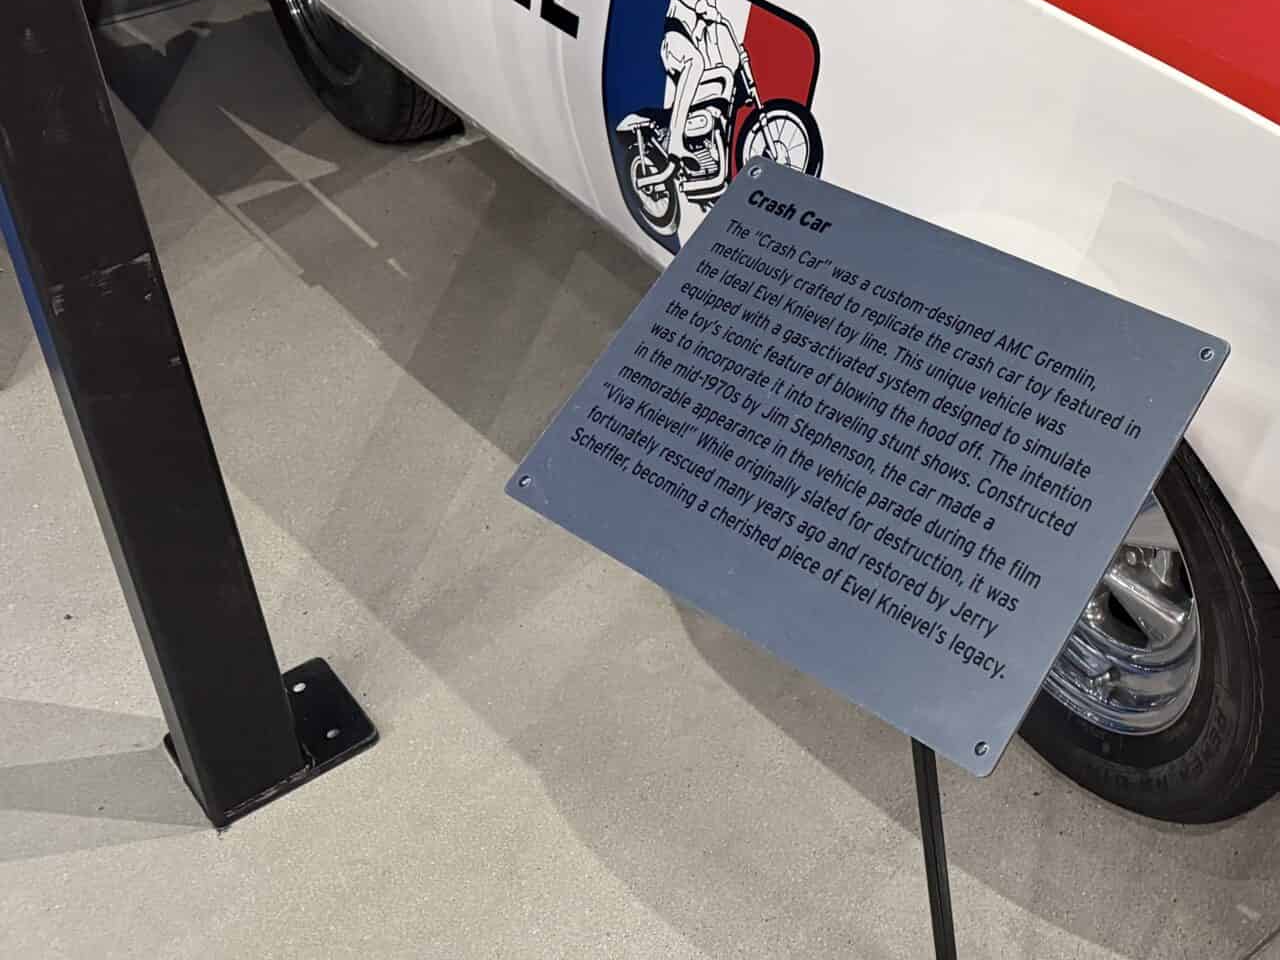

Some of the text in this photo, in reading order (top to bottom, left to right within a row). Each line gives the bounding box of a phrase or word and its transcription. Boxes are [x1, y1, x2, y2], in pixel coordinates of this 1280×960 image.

[725, 218, 750, 239] The
[831, 266, 859, 285] was
[859, 279, 870, 291] a
[872, 284, 995, 343] custom-designed
[993, 334, 1033, 359] AMC
[1034, 351, 1095, 392] Gremlin,
[747, 189, 832, 233] Crash Car
[633, 340, 995, 531] in the mid-1970s by Jim Stephenson, the car made a
[650, 322, 1078, 536] was to incorporate it into traveling stunt shows. Constructed
[665, 299, 688, 320] the
[721, 325, 763, 355] iconic
[762, 345, 814, 379] feature
[815, 372, 835, 386] of
[831, 377, 888, 417] blowing
[889, 404, 915, 427] the
[916, 417, 959, 446] hood
[957, 440, 984, 461] off.
[988, 449, 1017, 476] The
[1018, 464, 1092, 512] intention
[680, 282, 1091, 479] equipped with a gas-activated system designed to simulate
[695, 259, 1066, 435] the Ideal Evel Knievel toy line. This unique vehicle was
[710, 242, 1141, 439] meticulously crafted to replicate the crash car toy featured in
[570, 427, 630, 472] Scheffler,
[631, 459, 697, 509] becoming
[696, 499, 709, 512] a
[709, 506, 782, 551] cherished
[776, 544, 820, 574] piece
[821, 568, 843, 584] of
[840, 574, 877, 604] Evel
[947, 633, 1005, 679] legacy.
[586, 405, 999, 639] fortunately rescued many years ago and restored by Jerry
[617, 365, 1041, 589] memorable appearance in the vehicle parade during the film
[695, 431, 734, 461] While
[734, 455, 801, 499] originally
[800, 489, 850, 520] slated
[847, 510, 873, 533] for
[873, 526, 963, 587] destruction,
[968, 572, 984, 593] it
[986, 585, 1019, 612] was
